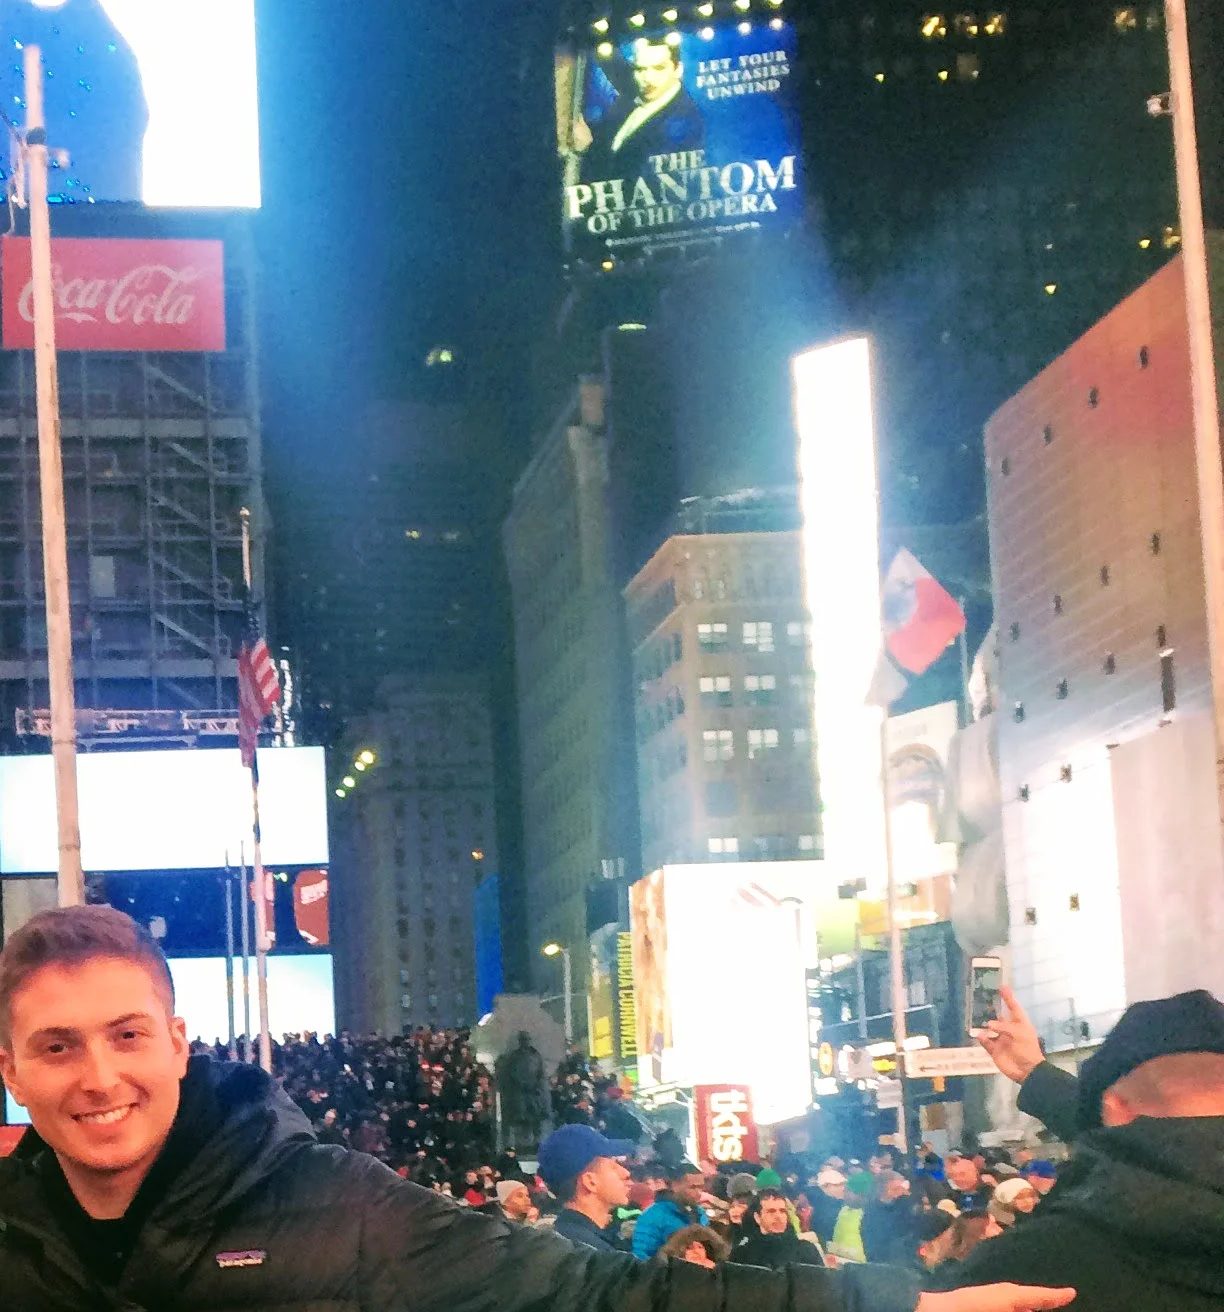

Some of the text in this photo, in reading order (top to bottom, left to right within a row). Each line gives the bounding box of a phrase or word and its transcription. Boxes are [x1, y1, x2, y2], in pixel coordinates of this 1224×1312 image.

[698, 50, 788, 74] LET YOUR
[696, 64, 790, 88] FANTASIES
[707, 80, 781, 100] UNWIND
[649, 150, 706, 174] THE
[565, 155, 797, 220] PHANTOM
[587, 210, 623, 234] OF
[627, 203, 683, 228] THE
[686, 193, 778, 221] OPERA
[710, 1089, 750, 1162] tkts
